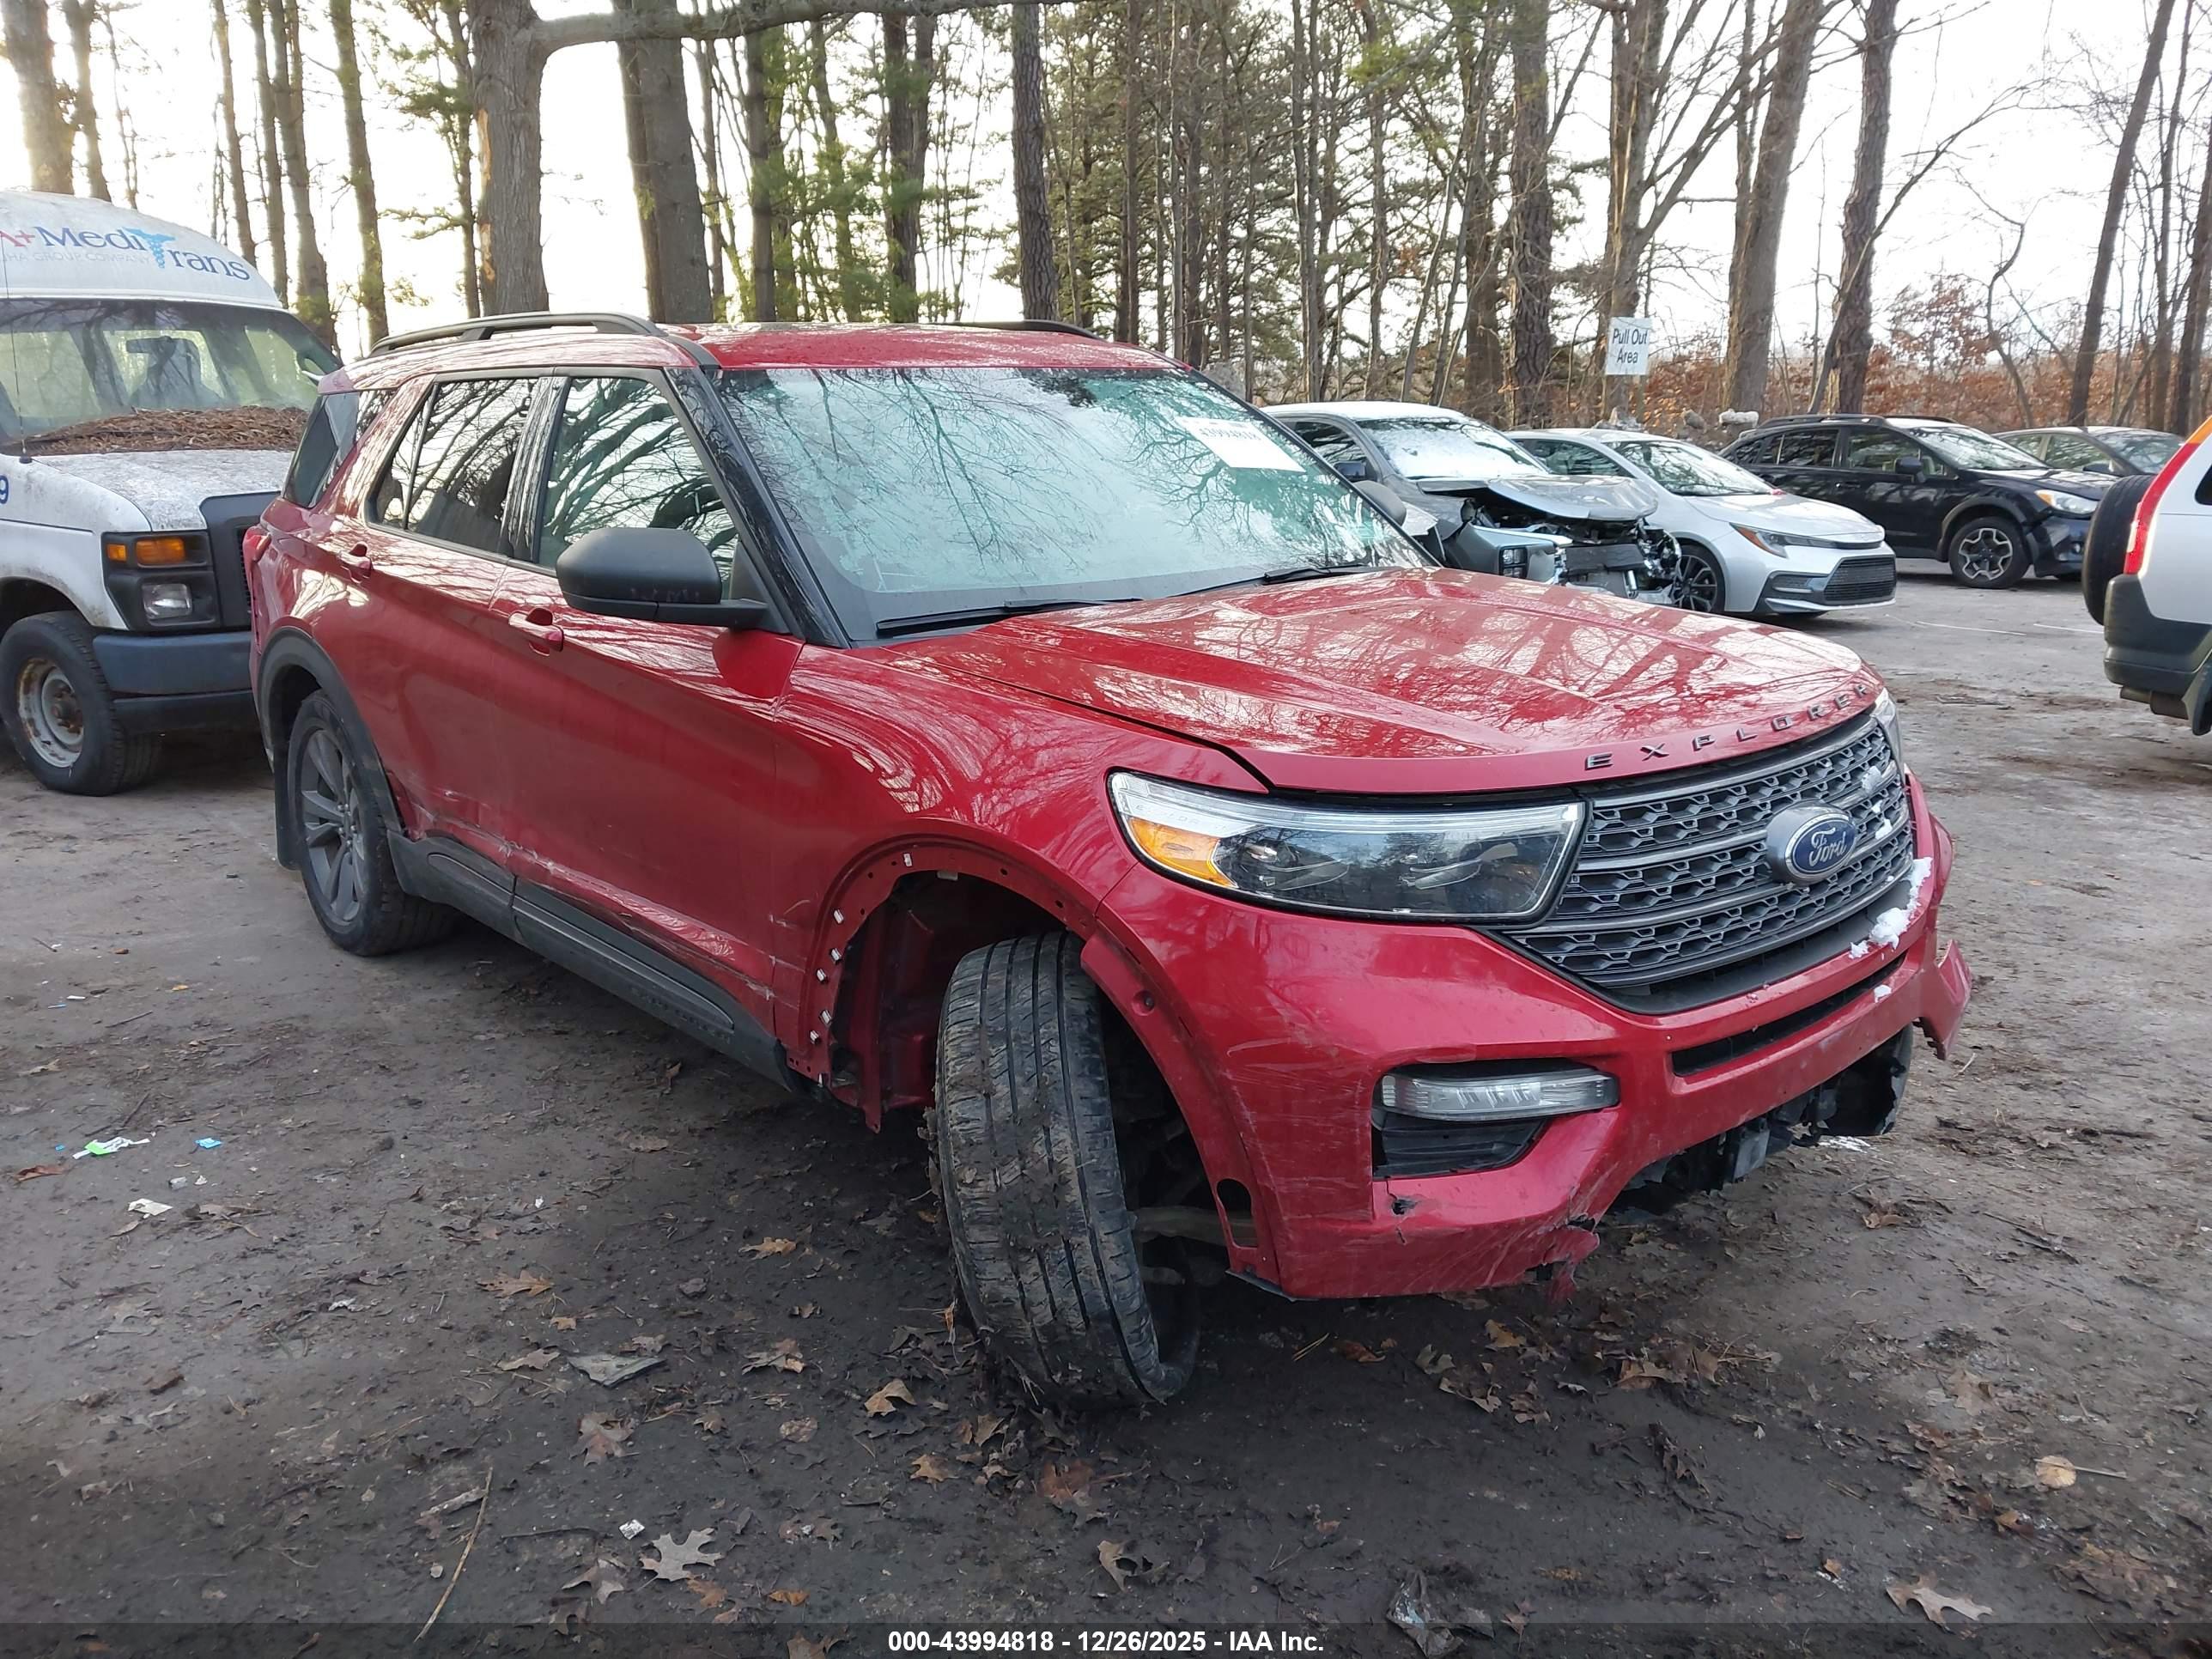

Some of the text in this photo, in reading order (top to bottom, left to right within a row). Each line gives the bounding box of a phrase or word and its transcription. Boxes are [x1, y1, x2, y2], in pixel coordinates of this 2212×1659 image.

[1612, 328, 1648, 345] Pull Out
[1616, 348, 1638, 363] Area
[1586, 683, 1868, 770] EXPLORER
[1808, 827, 1847, 867] Ford
